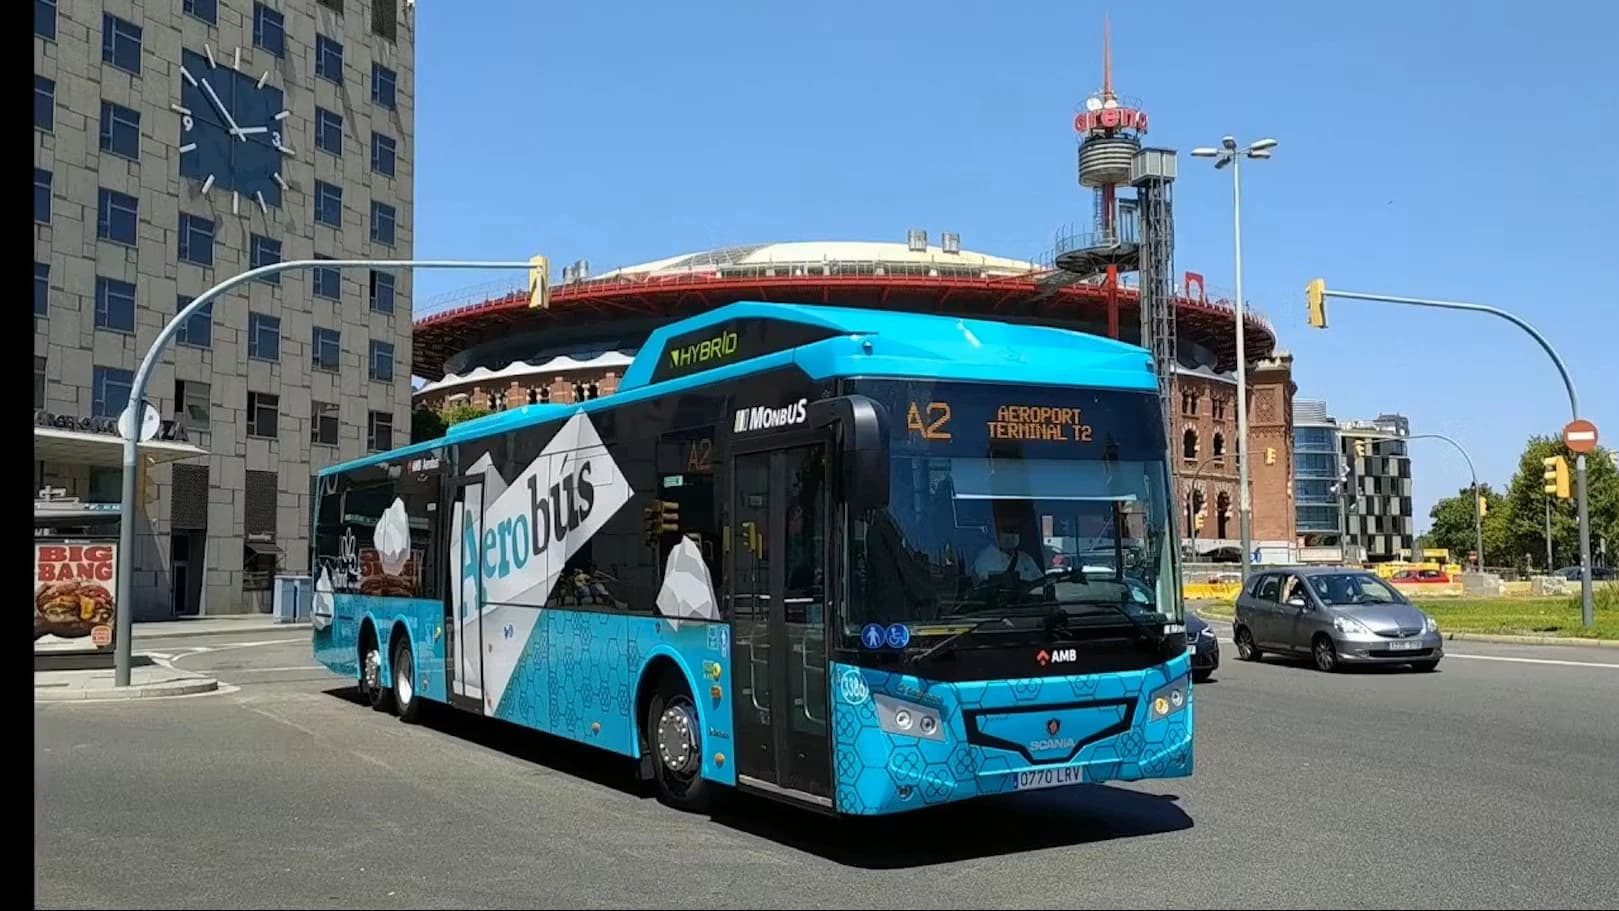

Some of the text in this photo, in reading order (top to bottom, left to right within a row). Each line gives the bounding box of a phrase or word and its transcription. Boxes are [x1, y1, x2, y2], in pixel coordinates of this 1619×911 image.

[183, 116, 193, 131] 9
[272, 131, 280, 147] 3
[680, 330, 738, 367] HYBRID
[907, 402, 952, 439] A2
[998, 405, 1081, 424] AEROPORT
[987, 422, 1092, 441] TERMINAL T2
[688, 438, 712, 473] A2
[38, 546, 113, 562] BIG
[38, 563, 113, 581] BANG
[1051, 649, 1077, 663] AMB
[1030, 738, 1075, 751] SCANIA
[1020, 766, 1080, 787] 0770 LRV
